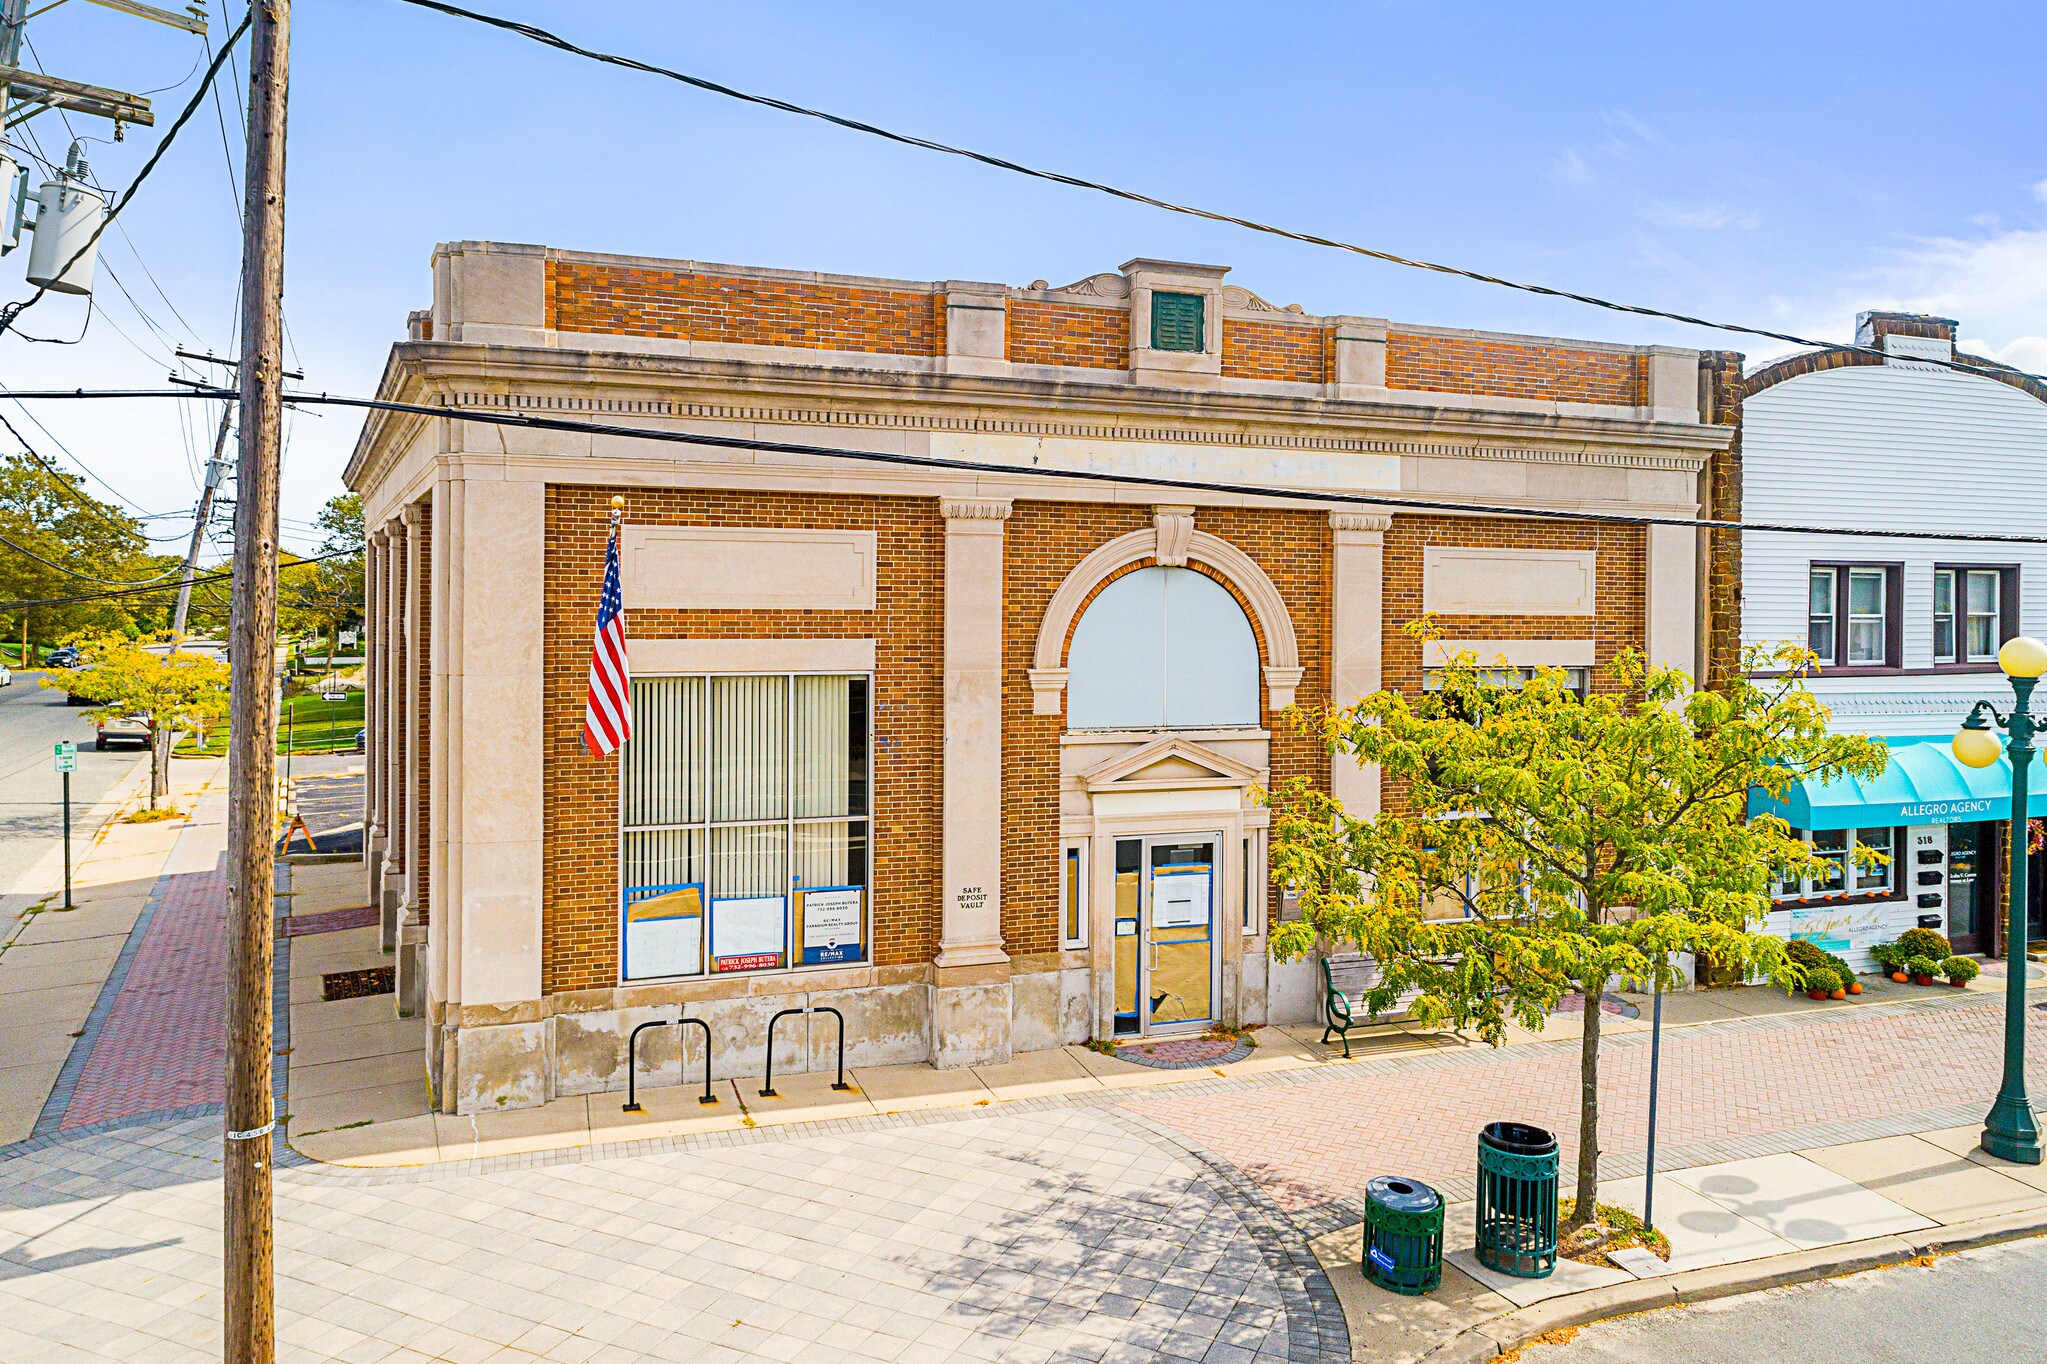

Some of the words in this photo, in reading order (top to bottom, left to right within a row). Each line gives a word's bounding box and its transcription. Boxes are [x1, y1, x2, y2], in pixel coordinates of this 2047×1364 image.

[1900, 803, 1948, 817] ALLEGRO
[1949, 800, 1992, 814] AGENCY
[1931, 816, 1962, 824] REALTORS
